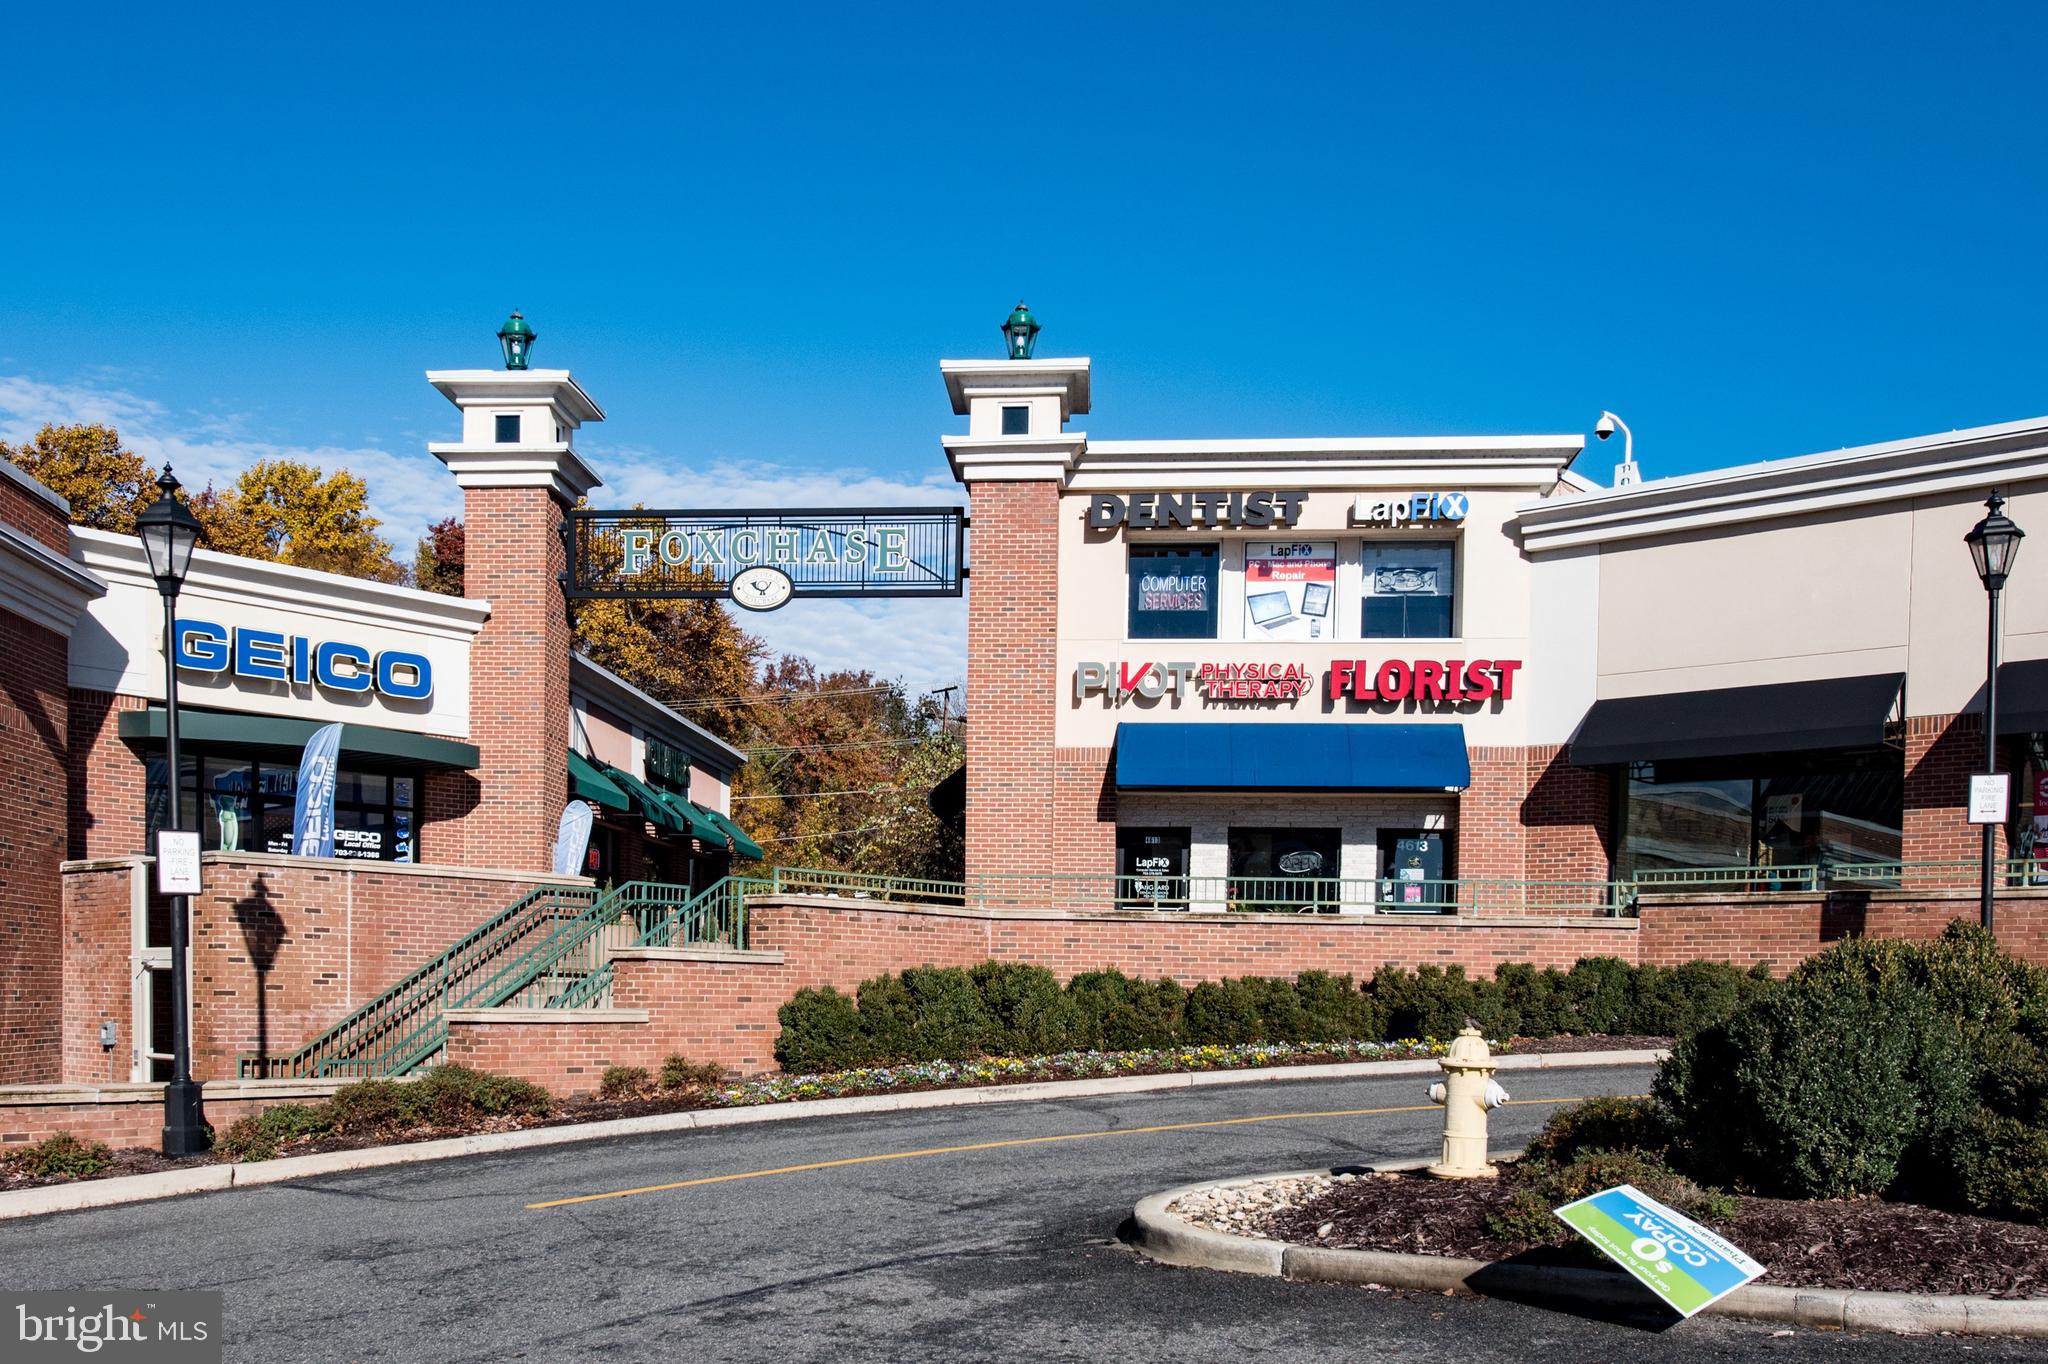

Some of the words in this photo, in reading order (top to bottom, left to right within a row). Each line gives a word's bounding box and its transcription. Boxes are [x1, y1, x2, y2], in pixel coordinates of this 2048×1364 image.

[1089, 491, 1309, 529] DENTIST
[619, 527, 911, 575] FOXCHASE
[1268, 560, 1286, 568] Mac
[1286, 560, 1303, 568] and
[1304, 560, 1332, 568] Phone
[1141, 575, 1207, 592] COMPUTER
[1271, 570, 1307, 581] Repair
[1144, 593, 1203, 610] SERVICES
[174, 618, 432, 700] GEICO
[1076, 661, 1196, 698] PIVOT
[1200, 662, 1312, 680] PHYSICAL
[1329, 658, 1523, 701] FLORIST
[1205, 680, 1306, 698] THERAPY
[301, 755, 327, 857] GEICO
[172, 838, 185, 846] NO
[333, 829, 382, 843] GEICO
[162, 847, 196, 857] PARKING
[1396, 840, 1429, 852] 4613
[1623, 1211, 1708, 1267] COPAY
[1688, 1224, 1747, 1265] Pharmacy
[1608, 1243, 1628, 1258] shot
[1626, 1256, 1638, 1266] flu
[1637, 1265, 1658, 1281] your
[1654, 1279, 1671, 1293] Get
